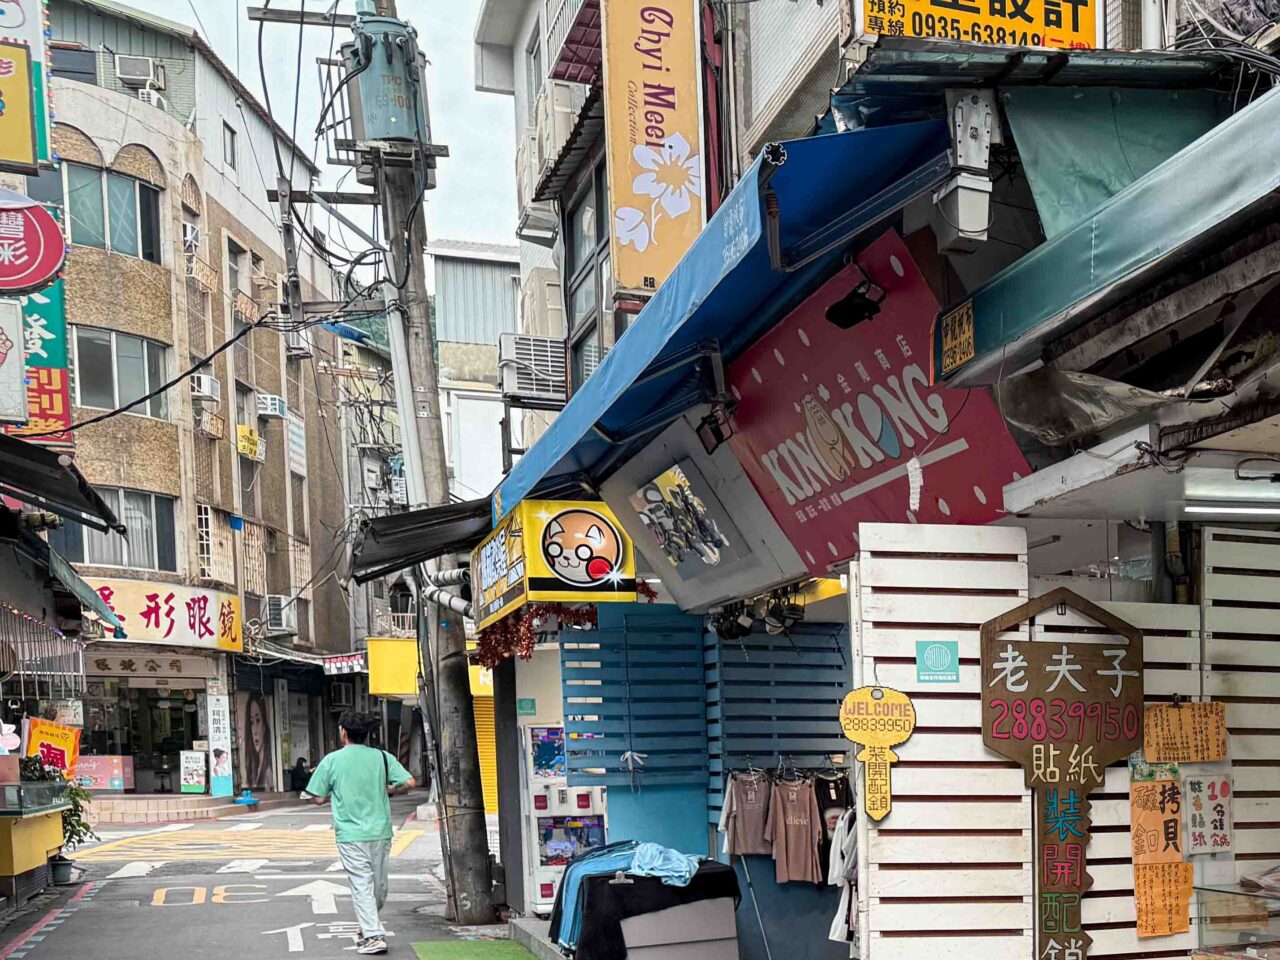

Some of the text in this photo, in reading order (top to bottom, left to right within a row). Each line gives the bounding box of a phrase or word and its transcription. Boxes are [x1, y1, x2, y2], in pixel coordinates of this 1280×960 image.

[867, 15, 905, 36] 專線
[633, 6, 676, 150] Chyi Meei
[627, 79, 638, 144] Collection
[0, 239, 29, 265] 彩
[831, 363, 948, 469] KONG
[988, 643, 1140, 698] 老夫子
[843, 718, 912, 733] 28839950
[844, 701, 911, 717] WELCOME
[989, 697, 1140, 742] 28839950
[866, 745, 888, 811] 裝開配鎖
[1031, 743, 1104, 784] 貼紙
[1159, 781, 1181, 853] 拷貝
